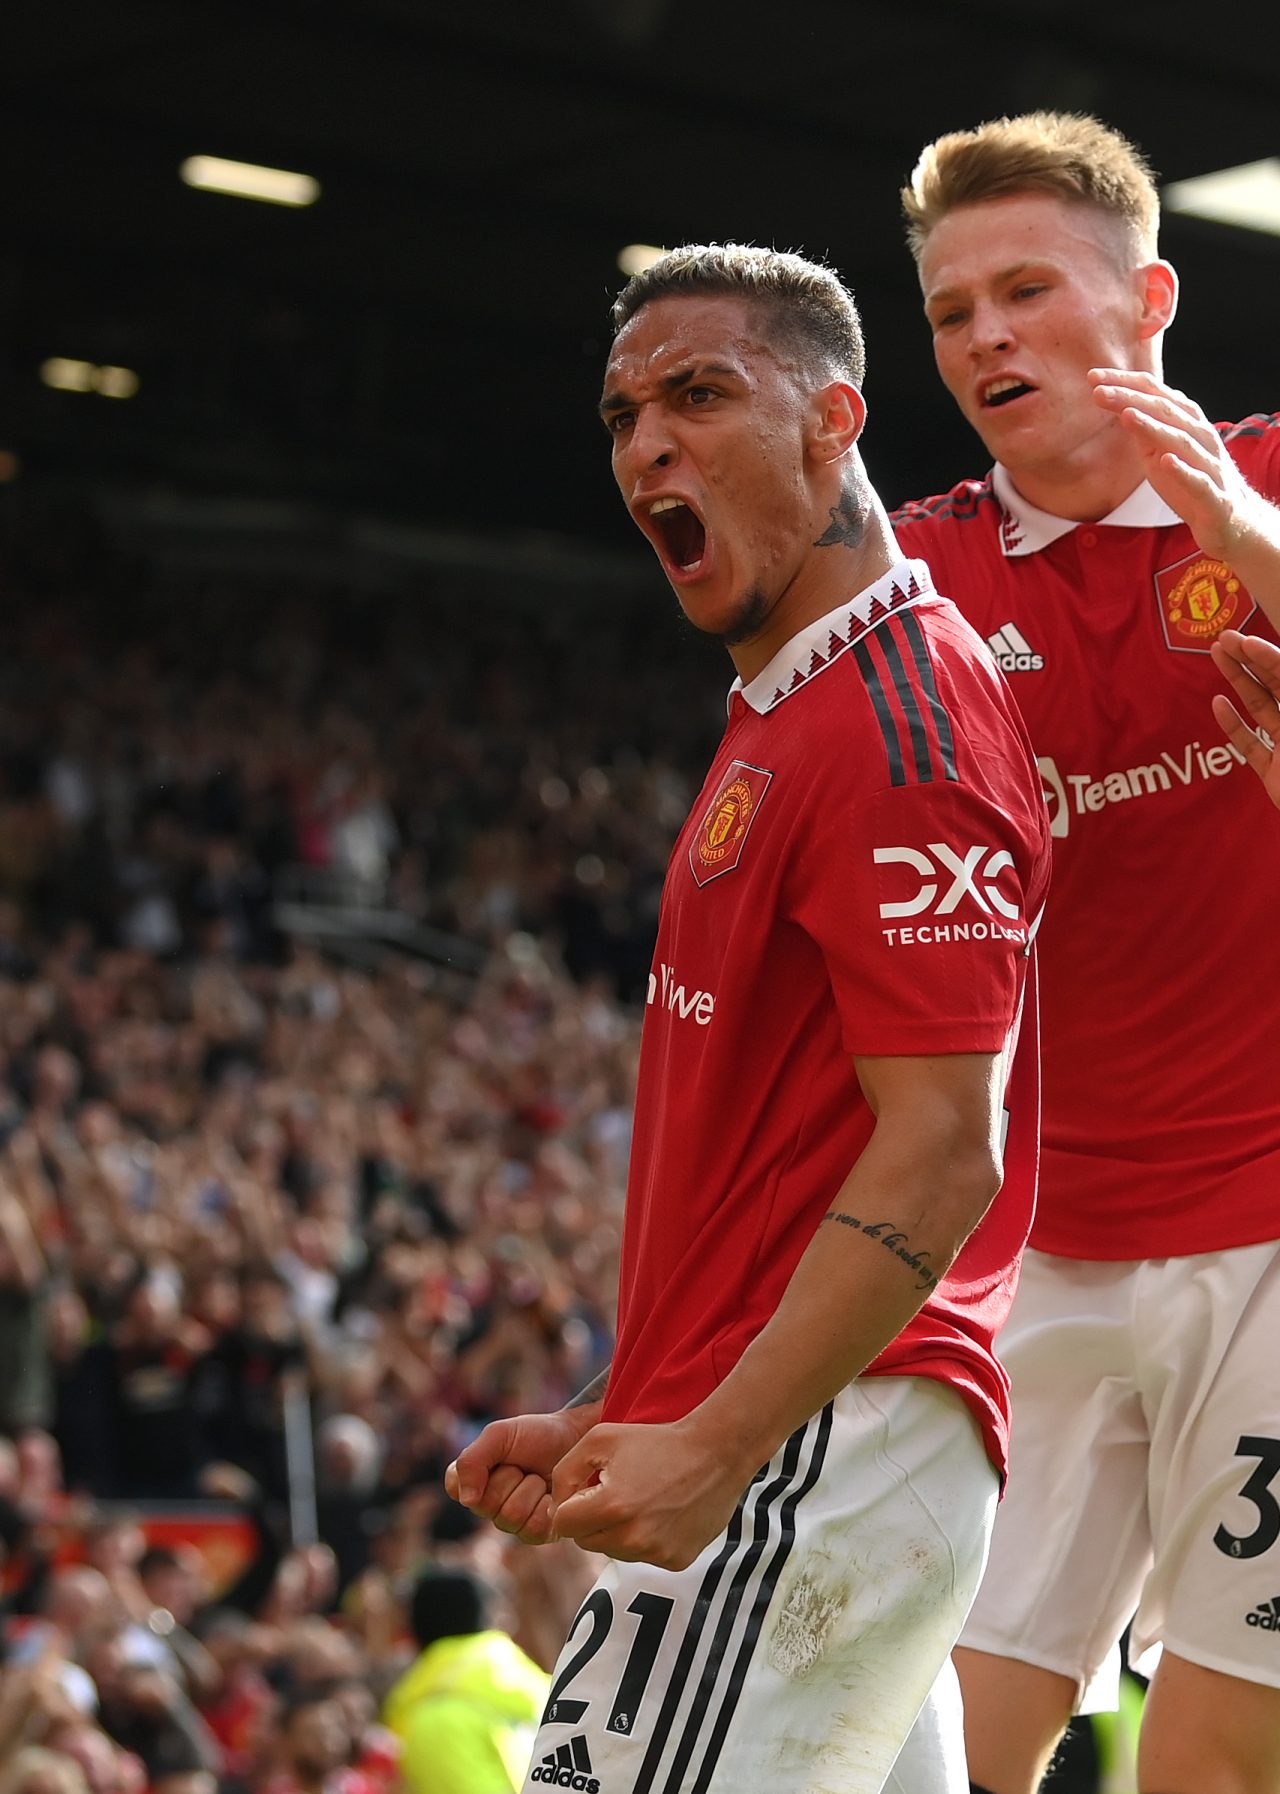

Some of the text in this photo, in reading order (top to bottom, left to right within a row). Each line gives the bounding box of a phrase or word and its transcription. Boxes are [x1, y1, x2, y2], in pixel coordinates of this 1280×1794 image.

[1190, 608, 1230, 632] UNITED
[996, 654, 1044, 671] idas
[701, 841, 725, 860] UNITED
[873, 843, 1019, 920] DXC
[540, 1588, 675, 1736] 21
[531, 1764, 601, 1794] adidas
